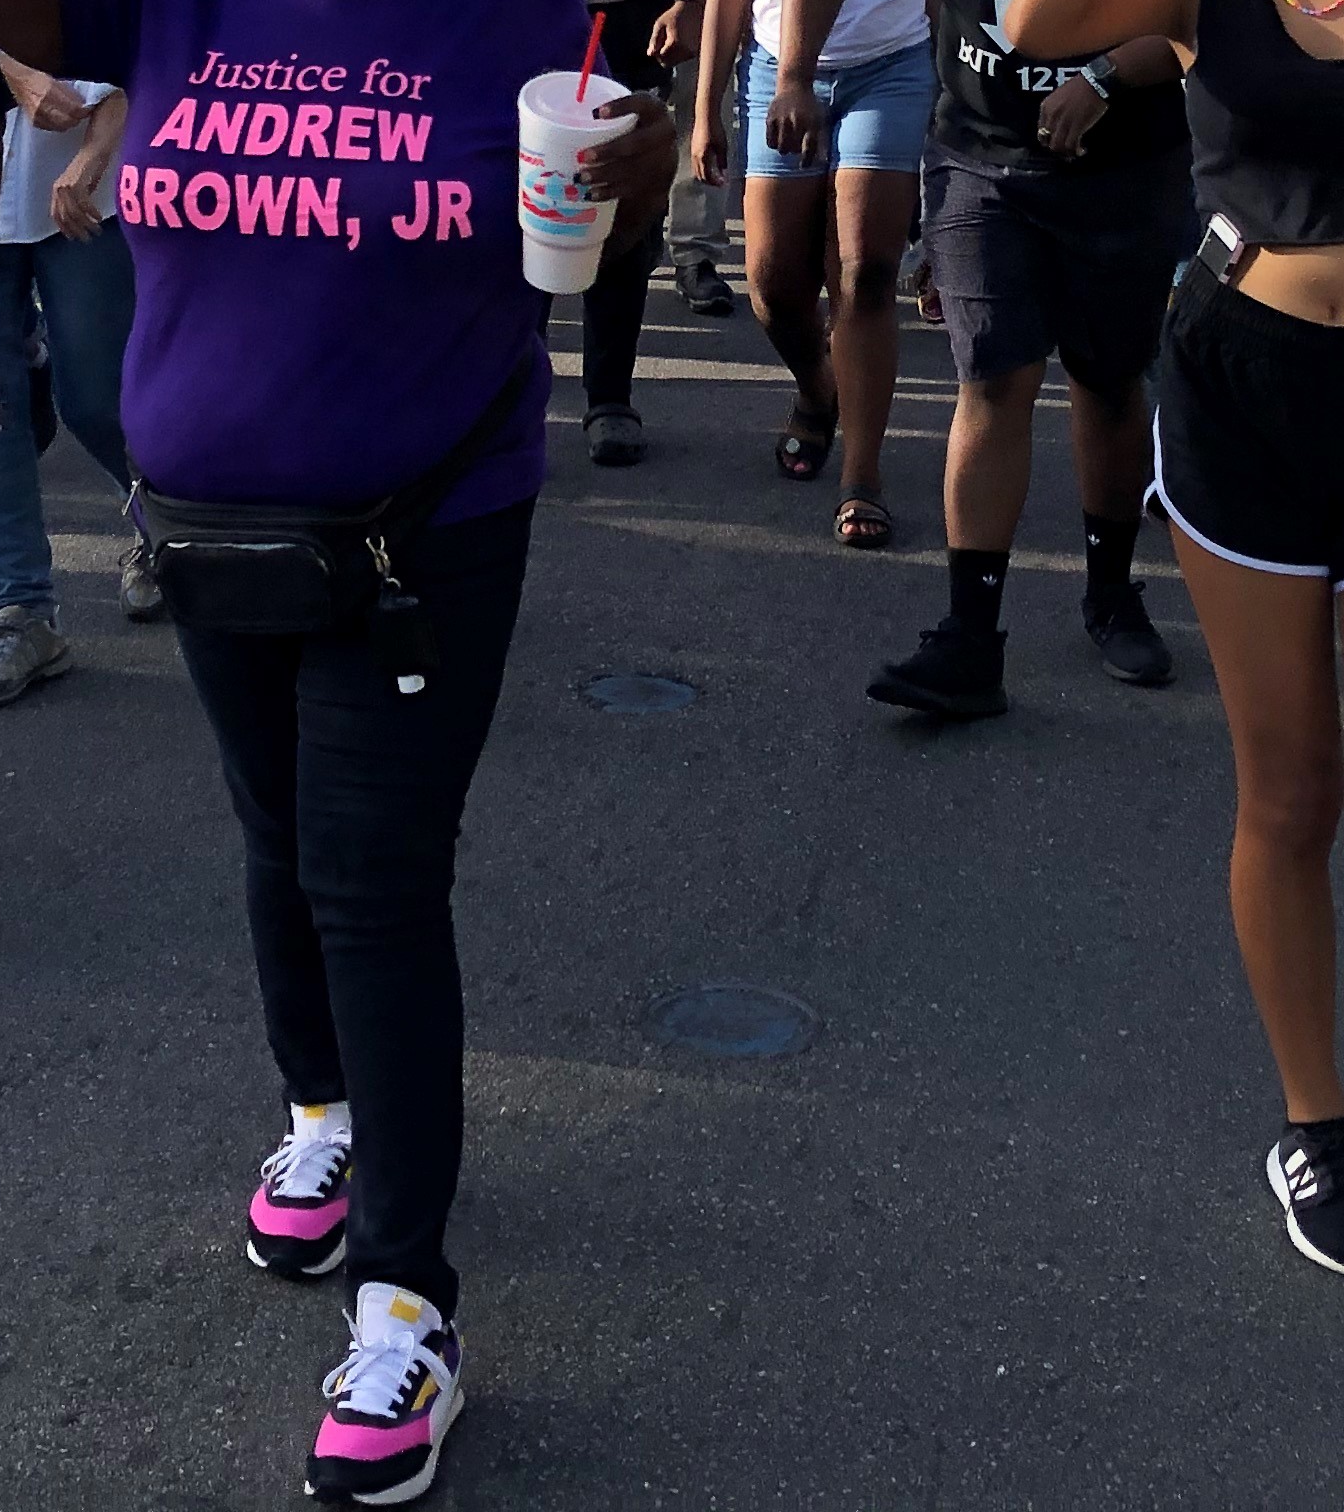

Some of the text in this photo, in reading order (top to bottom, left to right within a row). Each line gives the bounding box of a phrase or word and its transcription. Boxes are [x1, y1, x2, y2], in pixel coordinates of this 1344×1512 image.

[188, 50, 432, 100] Justice for
[958, 36, 1003, 76] BUT
[149, 97, 433, 163] ANDREW
[119, 164, 473, 251] BROWN, JR
